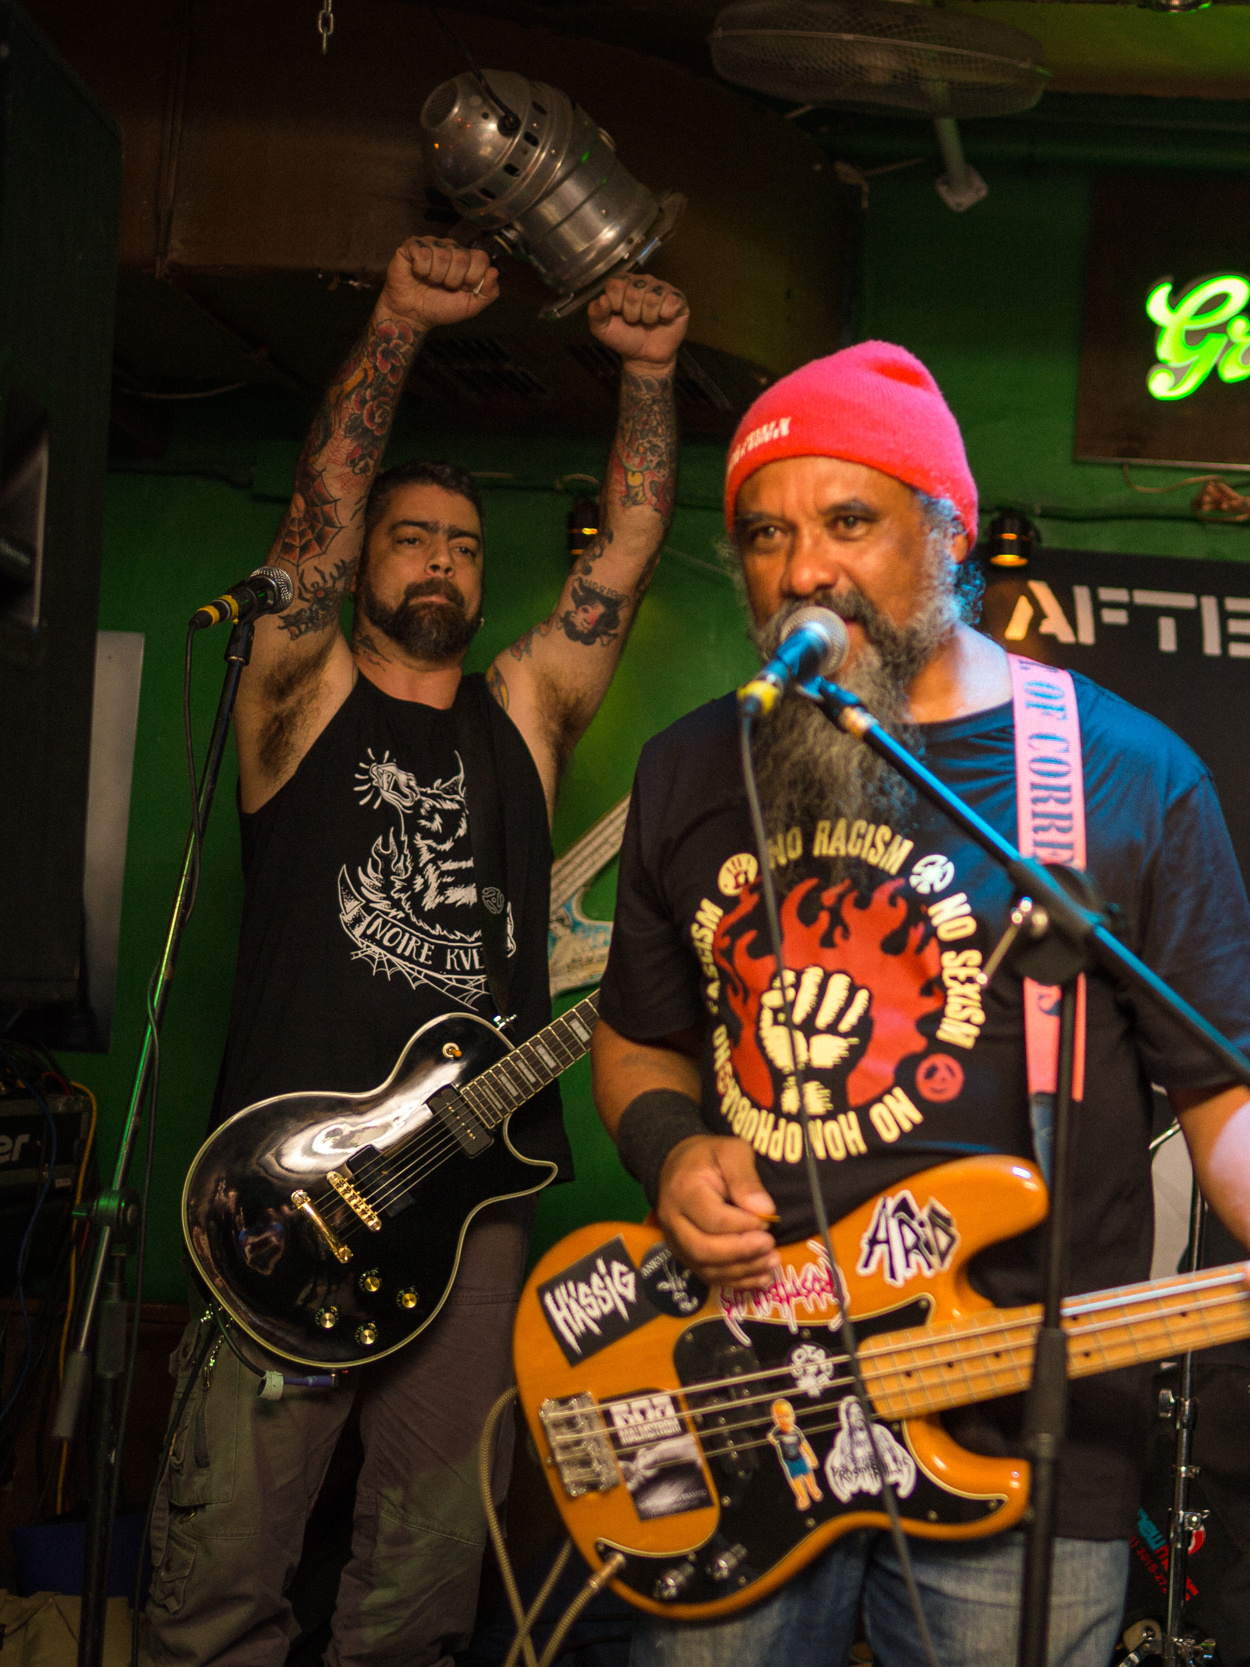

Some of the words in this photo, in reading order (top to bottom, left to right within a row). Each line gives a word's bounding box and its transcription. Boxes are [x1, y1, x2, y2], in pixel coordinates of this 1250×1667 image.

[1023, 679, 1068, 722] OF
[766, 826, 803, 870] NO
[812, 817, 915, 876] RACISM
[366, 917, 435, 965] NOIRE
[446, 947, 486, 972] KVE
[928, 892, 978, 942] NO
[936, 949, 987, 1050] SEXISM
[869, 1086, 924, 1143] NO
